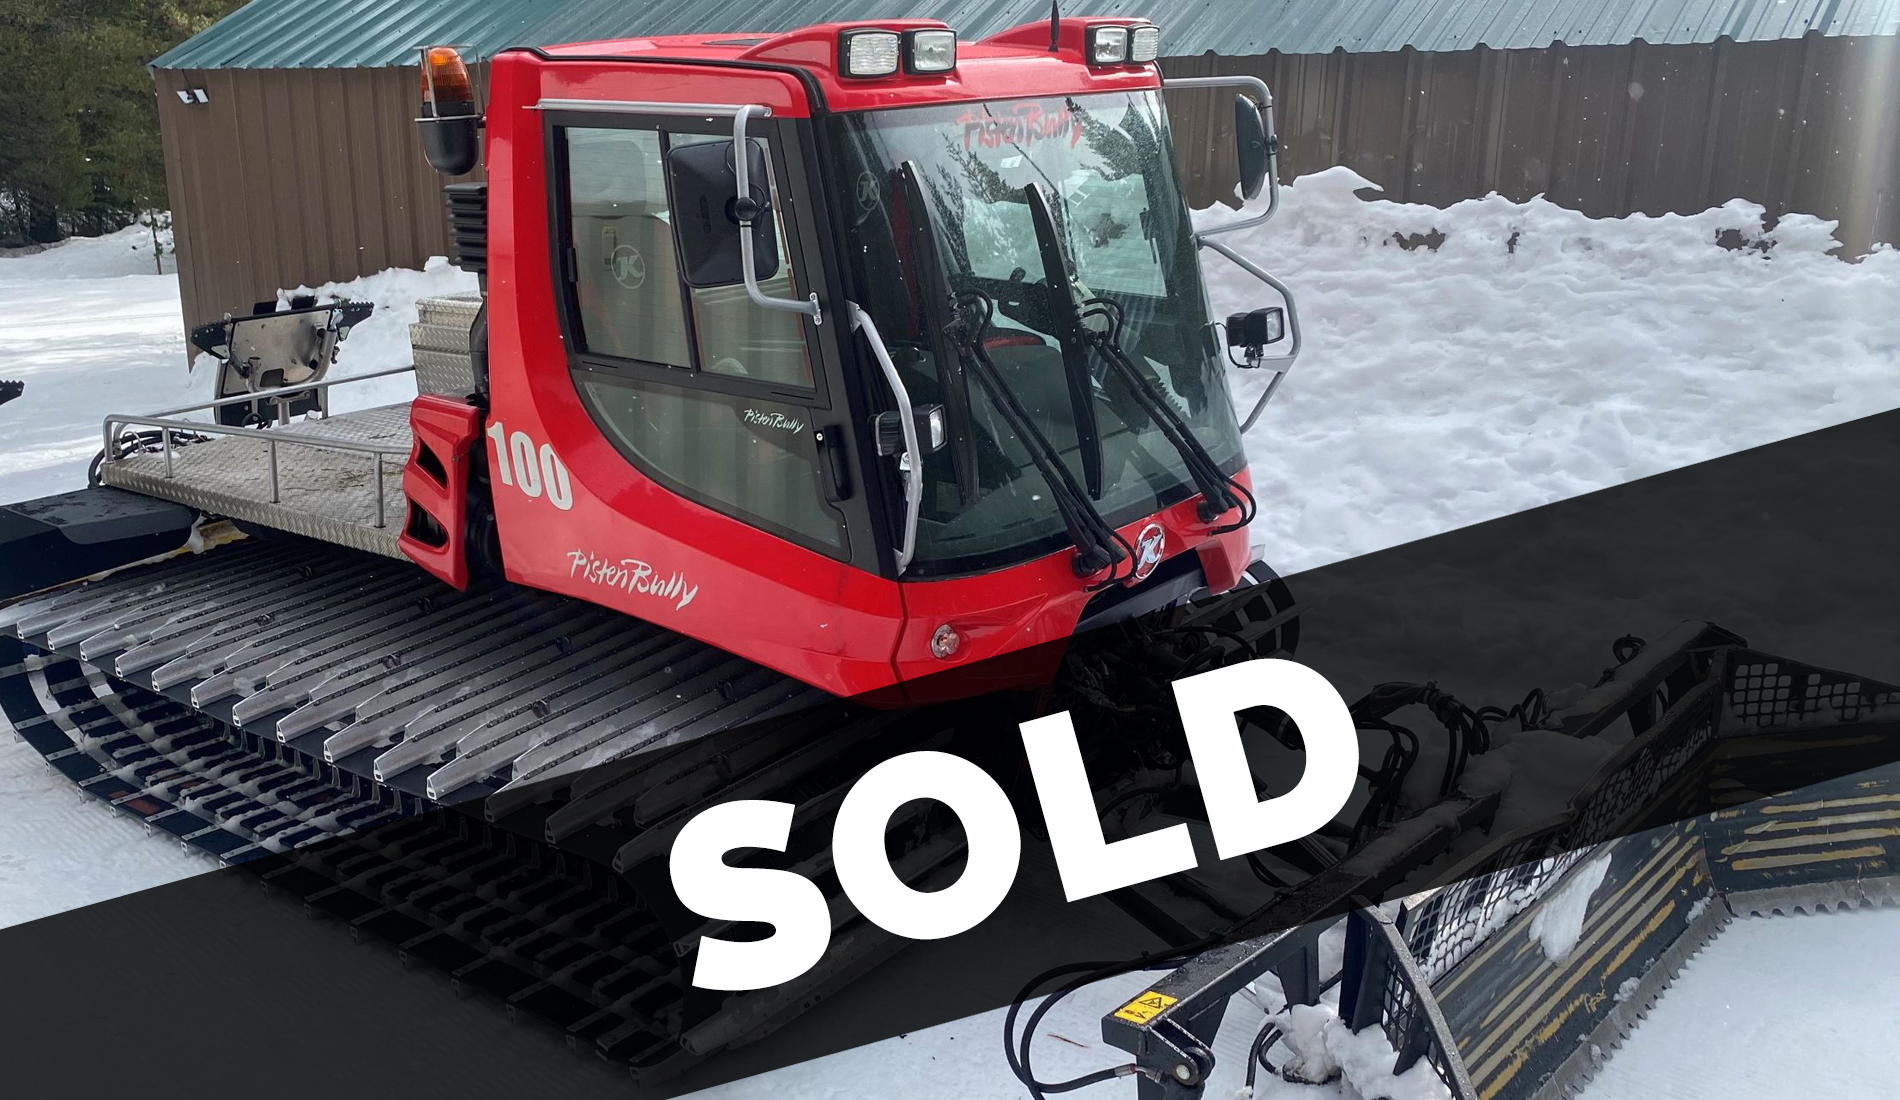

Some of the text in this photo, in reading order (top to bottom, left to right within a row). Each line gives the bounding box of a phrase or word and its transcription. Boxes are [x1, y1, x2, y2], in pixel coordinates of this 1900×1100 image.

[744, 408, 804, 435] PistenBully
[487, 421, 573, 511] 100
[567, 548, 699, 611] PistenBully
